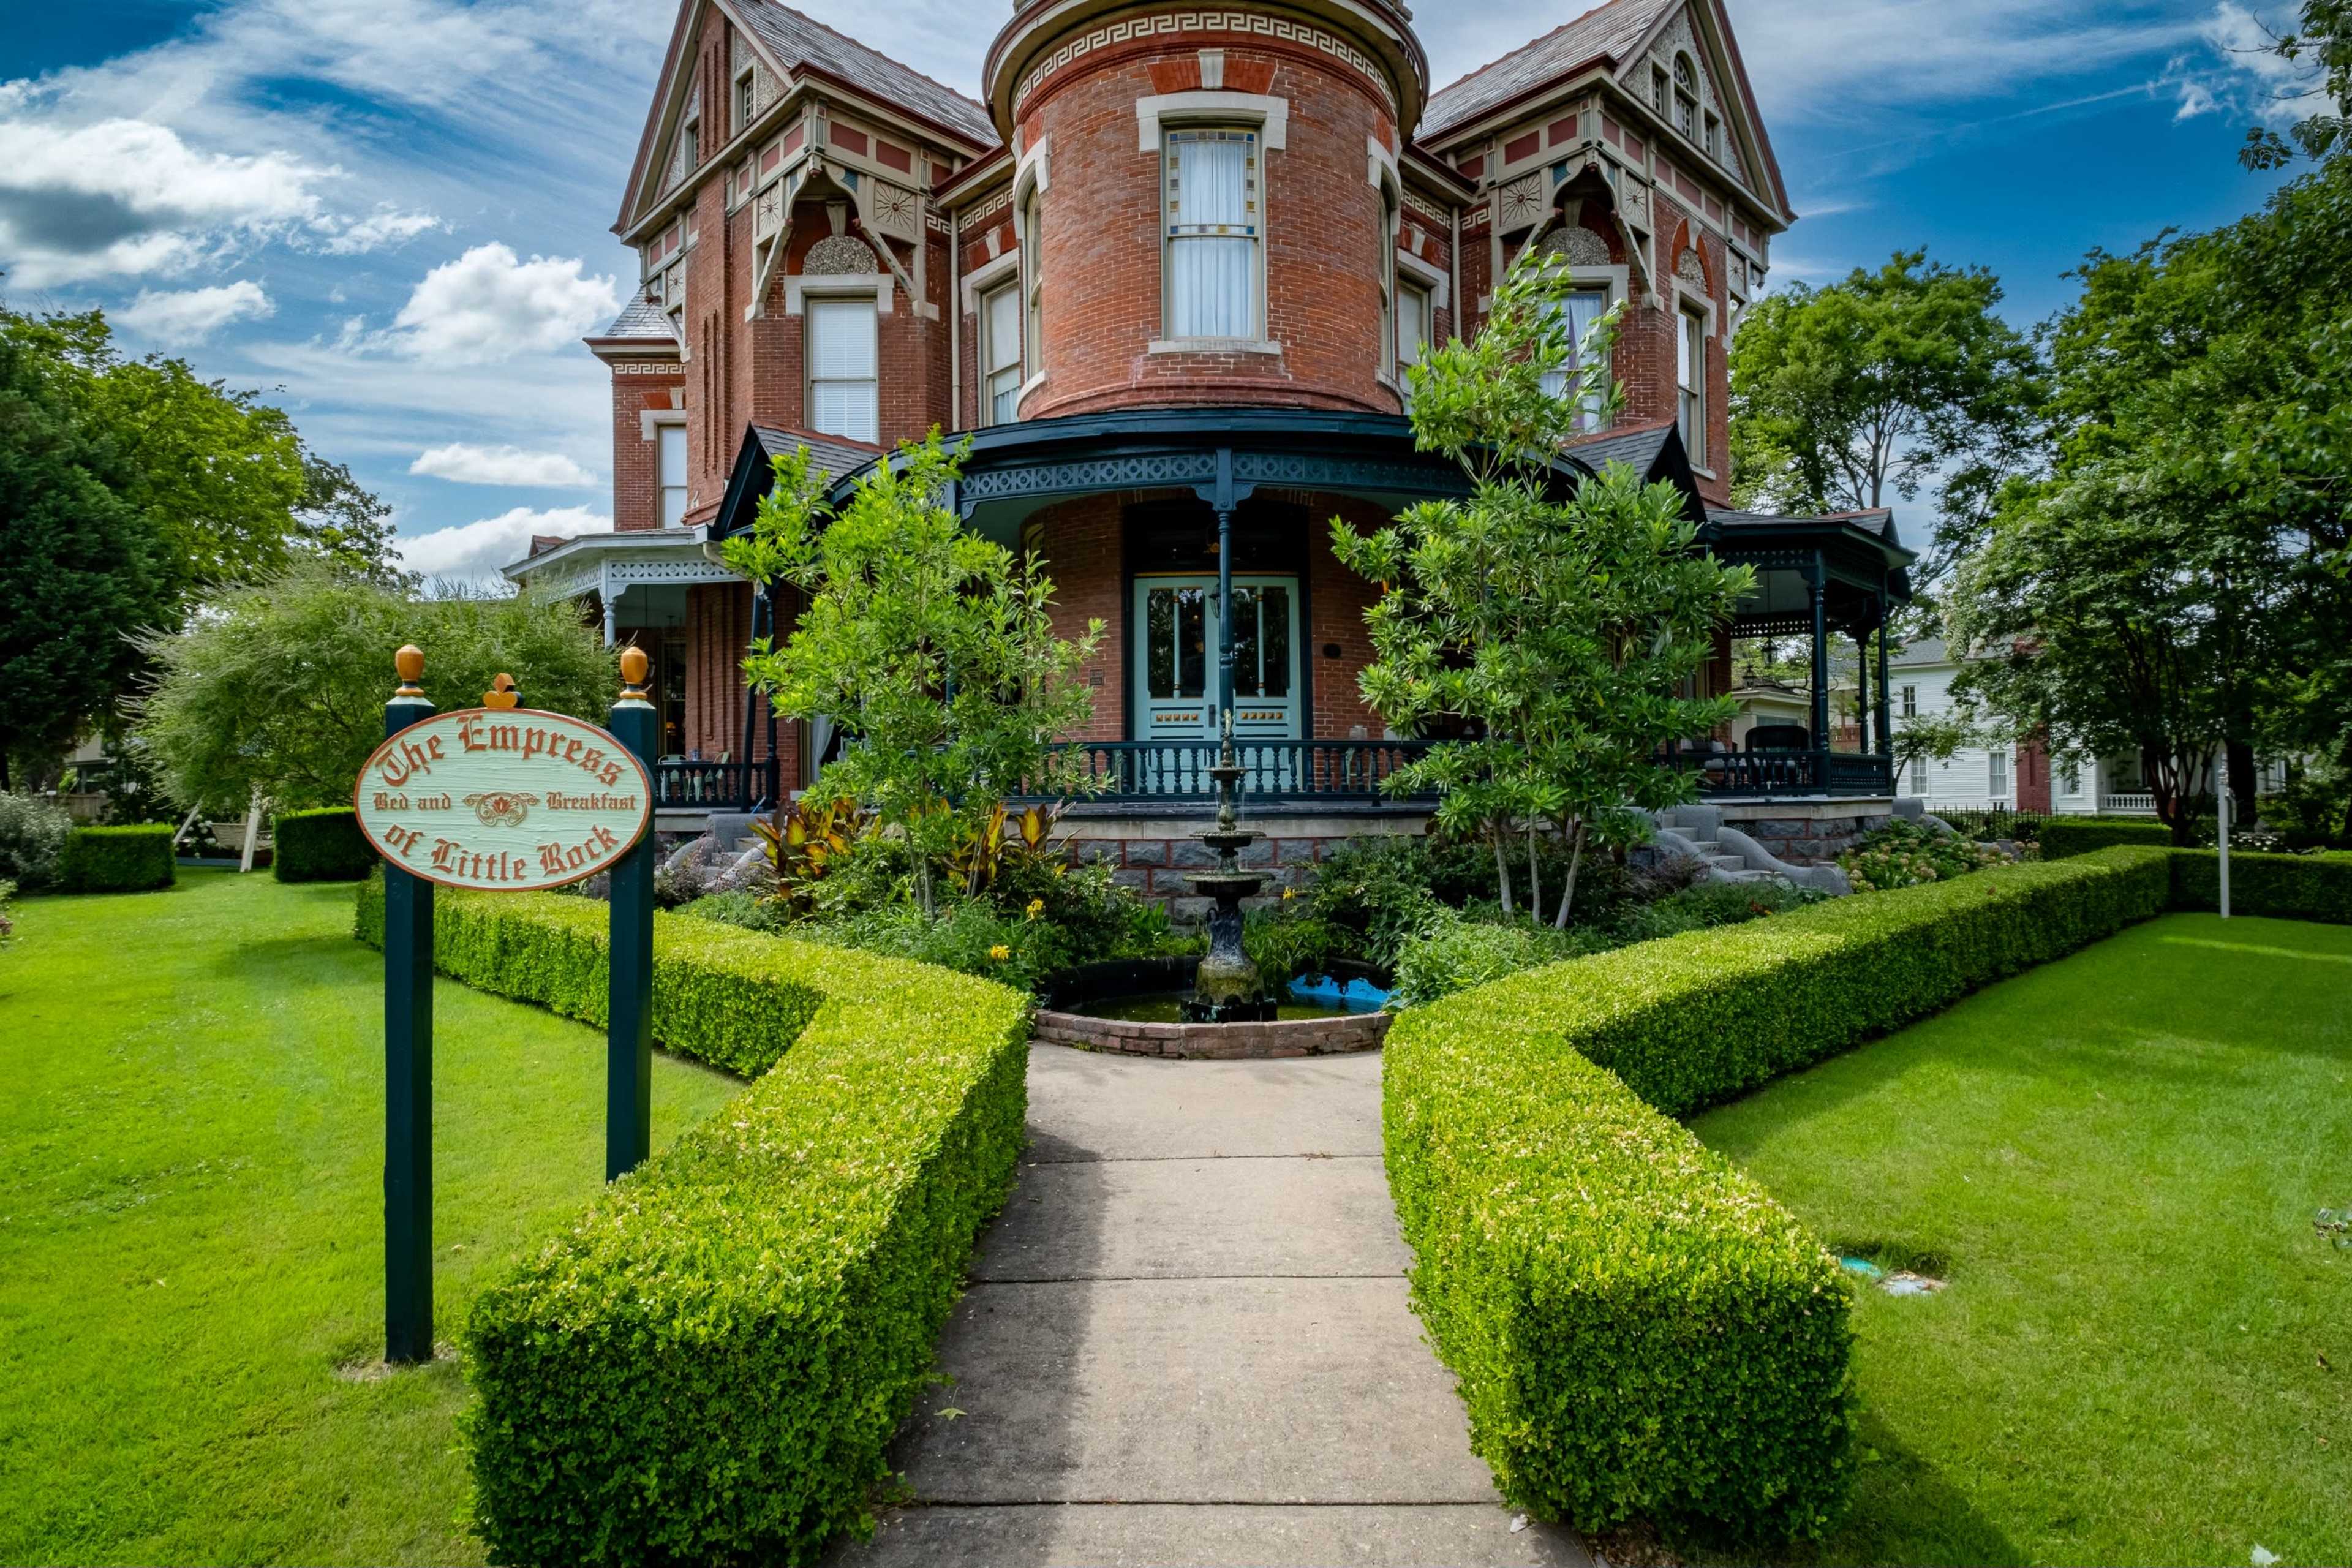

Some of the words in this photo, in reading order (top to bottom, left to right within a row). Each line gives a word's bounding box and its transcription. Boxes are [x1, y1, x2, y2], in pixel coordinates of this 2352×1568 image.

[376, 734, 445, 786] The
[457, 714, 625, 787] Empress
[373, 793, 407, 810] Bed
[418, 793, 450, 810] and
[546, 792, 636, 810] Breakfast
[384, 824, 424, 856] of
[431, 838, 526, 881] Little
[537, 824, 619, 876] Rock
